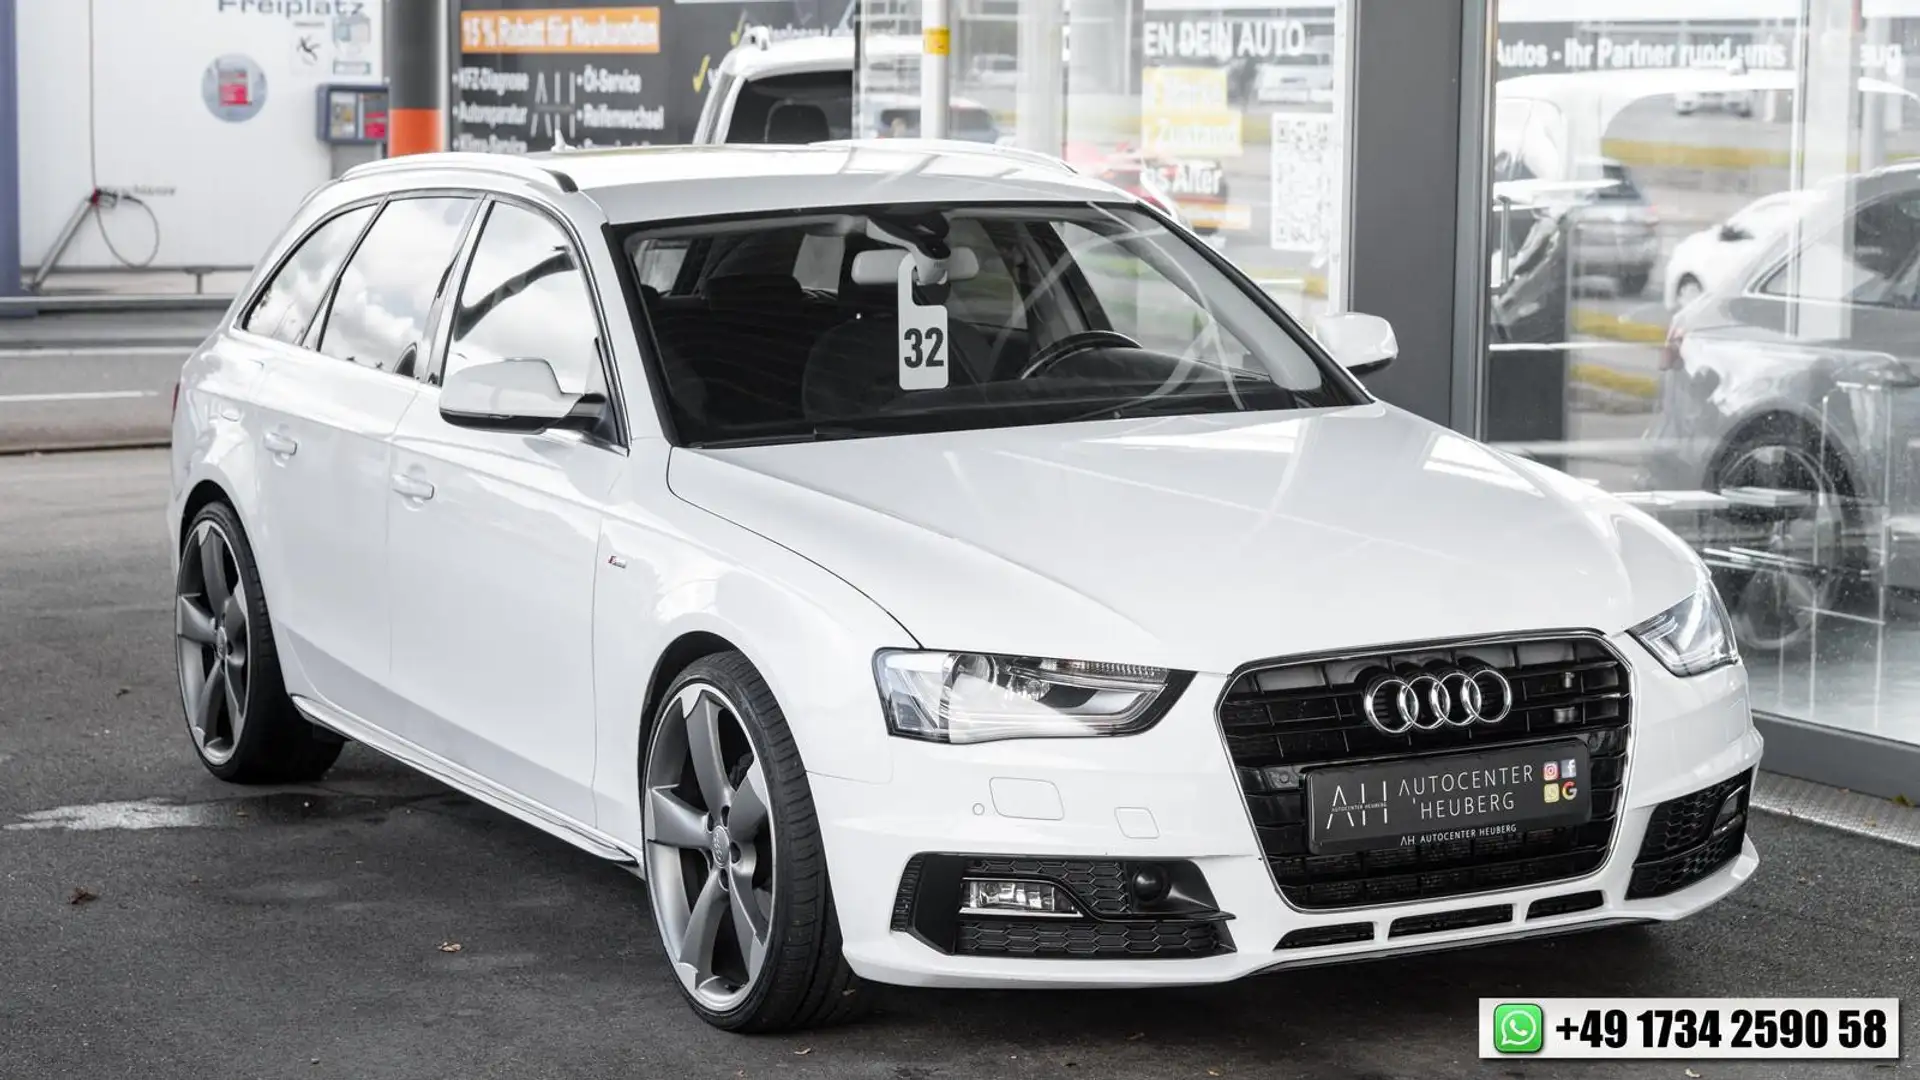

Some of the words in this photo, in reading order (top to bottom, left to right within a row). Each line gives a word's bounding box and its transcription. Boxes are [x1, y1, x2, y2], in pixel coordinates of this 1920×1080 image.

[218, 0, 364, 18] Freiplatz
[463, 16, 480, 46] 15
[1179, 20, 1234, 58] DEIN
[1236, 19, 1306, 57] AUTO
[1564, 37, 1594, 68] Ihr
[1597, 37, 1675, 68] Partner
[1679, 37, 1732, 68] rund
[583, 64, 641, 94] Öl-Service
[903, 326, 945, 369] 32
[1398, 764, 1534, 797] AUTOCENTER
[1420, 791, 1515, 820] HEUBERG
[1400, 835, 1416, 847] AH
[1419, 828, 1477, 844] AUTOCENTER
[1479, 823, 1517, 837] HEUBERG
